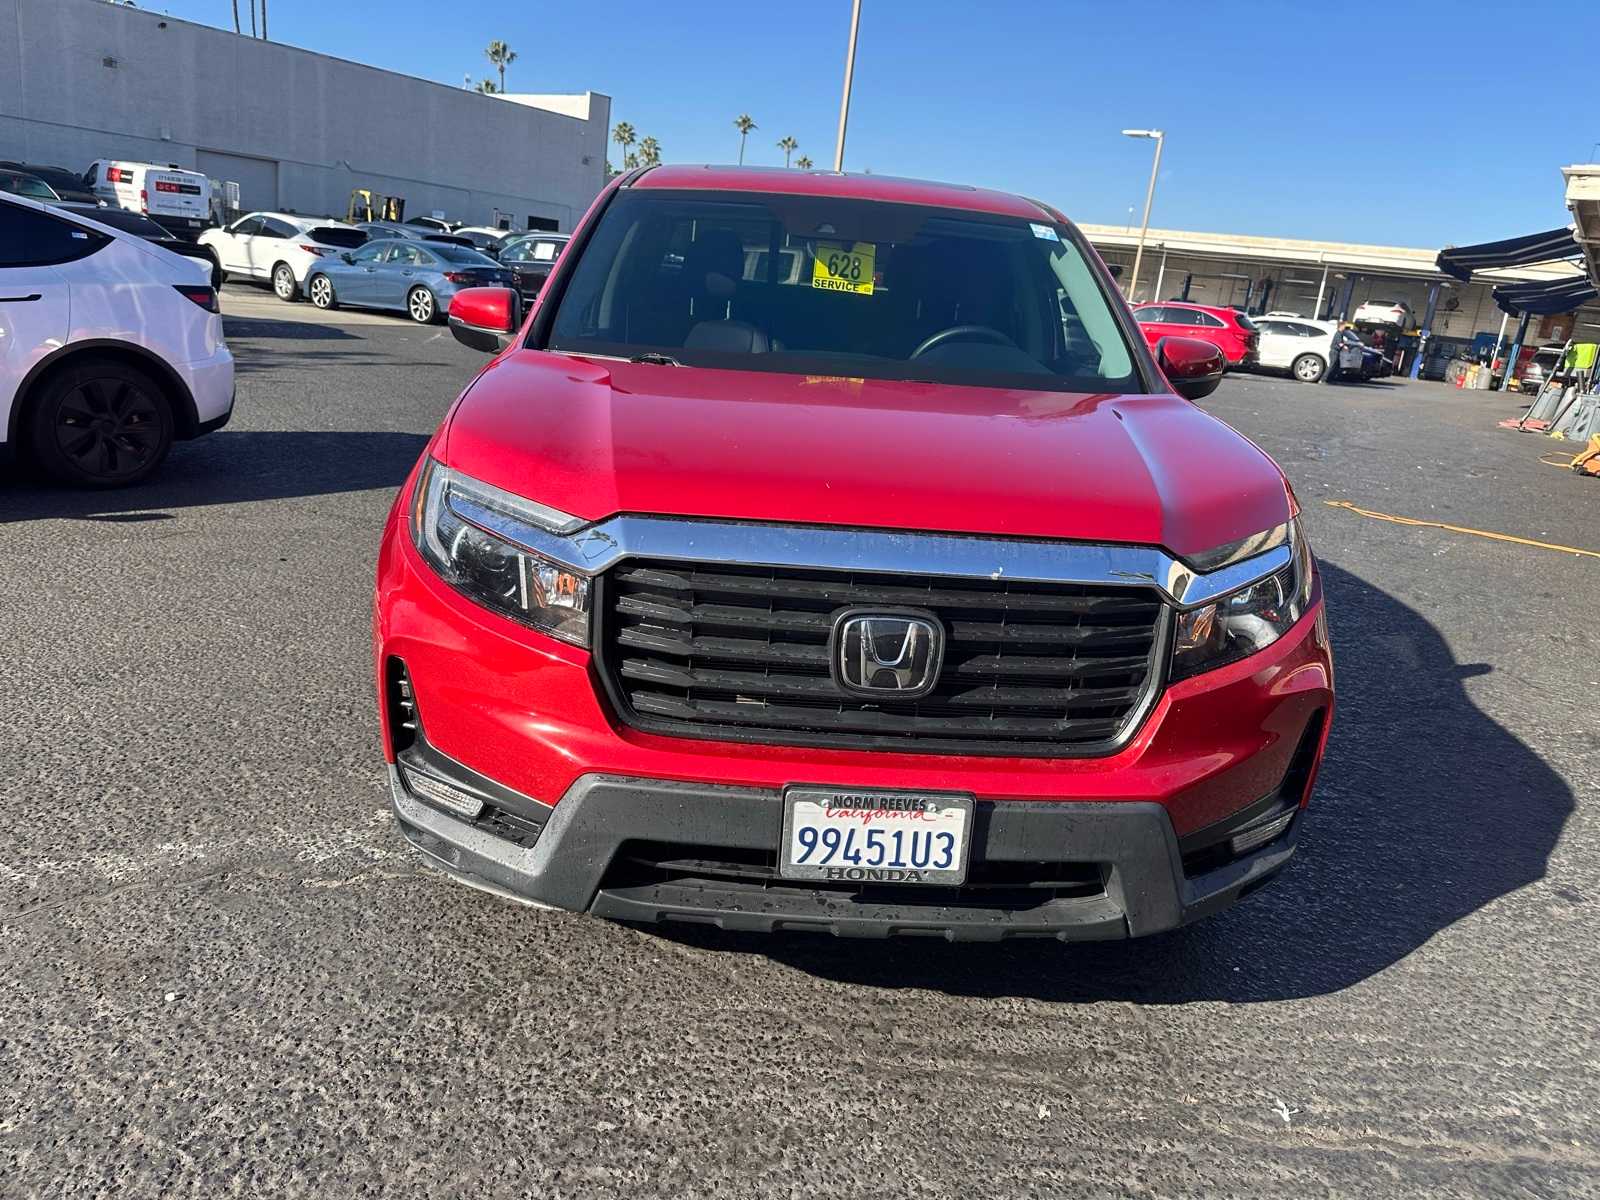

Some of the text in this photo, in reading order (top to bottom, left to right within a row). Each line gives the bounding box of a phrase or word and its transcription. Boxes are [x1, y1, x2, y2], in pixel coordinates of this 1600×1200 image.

[828, 253, 861, 280] 628
[814, 278, 860, 292] SERVICE
[832, 795, 927, 812] NORM REEVES
[797, 826, 955, 868] 99451U3
[826, 866, 923, 881] HONDA
